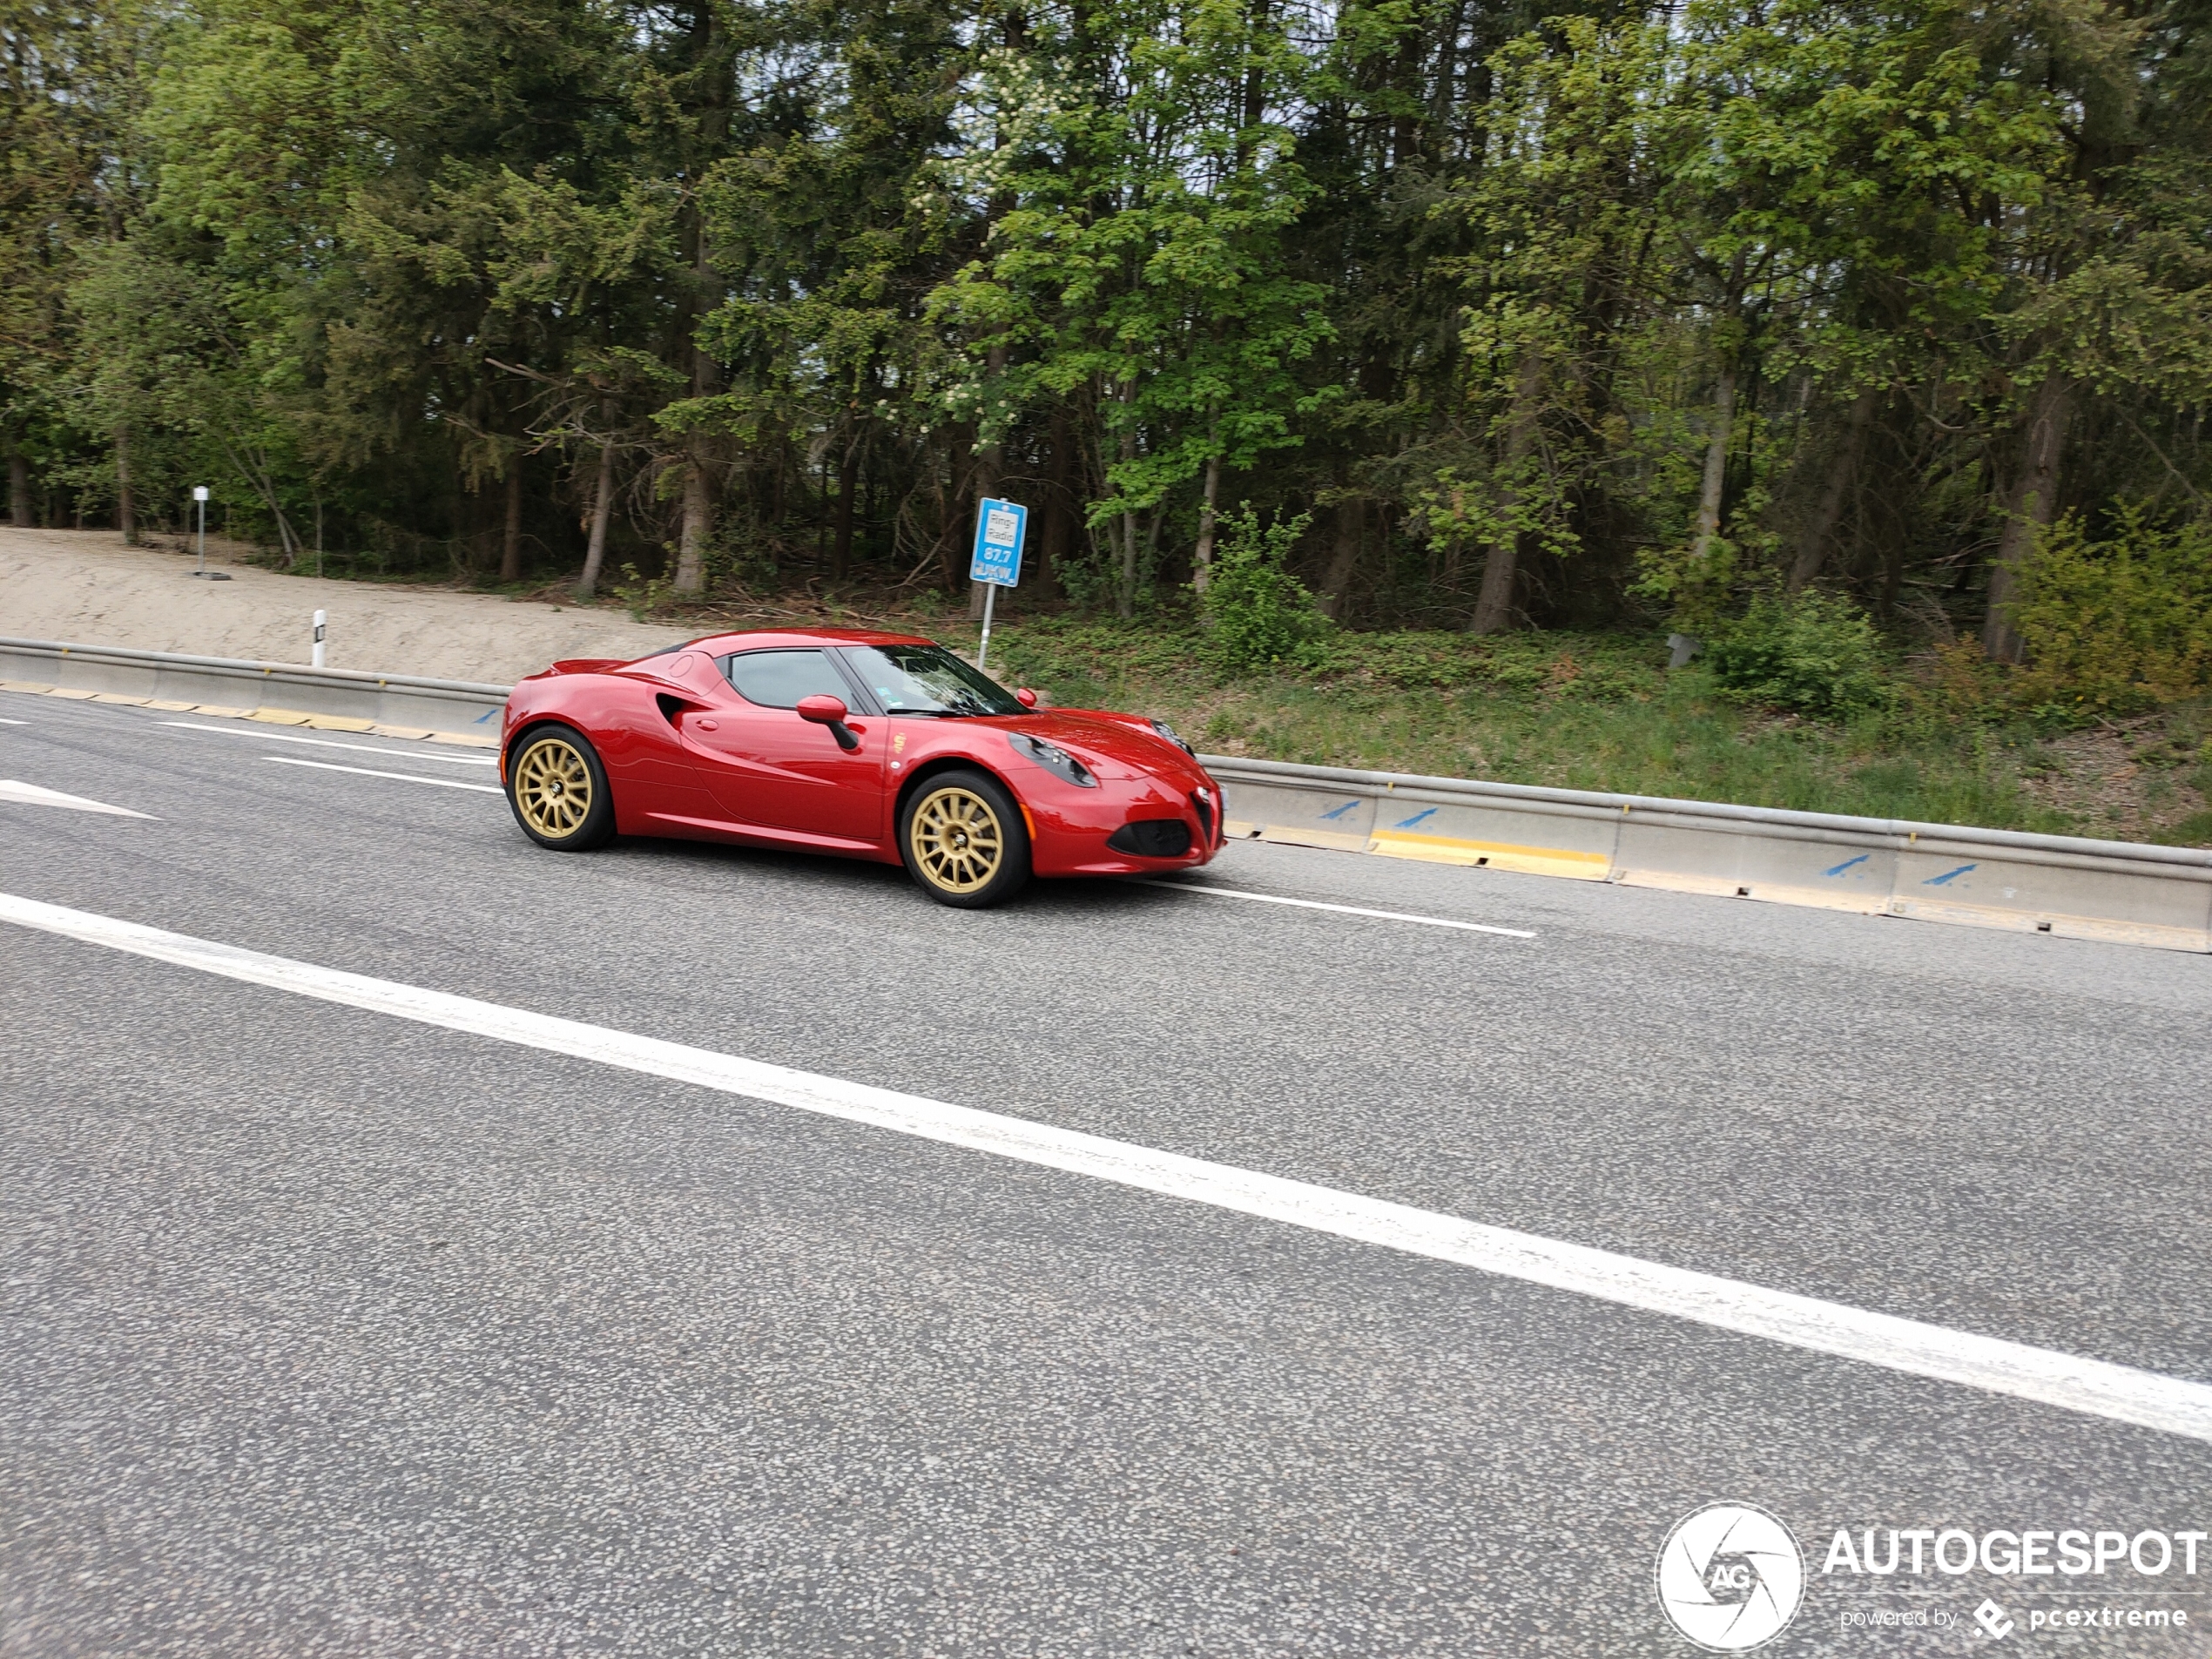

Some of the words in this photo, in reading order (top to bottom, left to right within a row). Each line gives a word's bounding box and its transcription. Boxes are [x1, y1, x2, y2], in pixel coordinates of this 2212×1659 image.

[990, 514, 1015, 529] Ring-
[988, 528, 1015, 542] Radio
[983, 547, 1012, 563] 87,7
